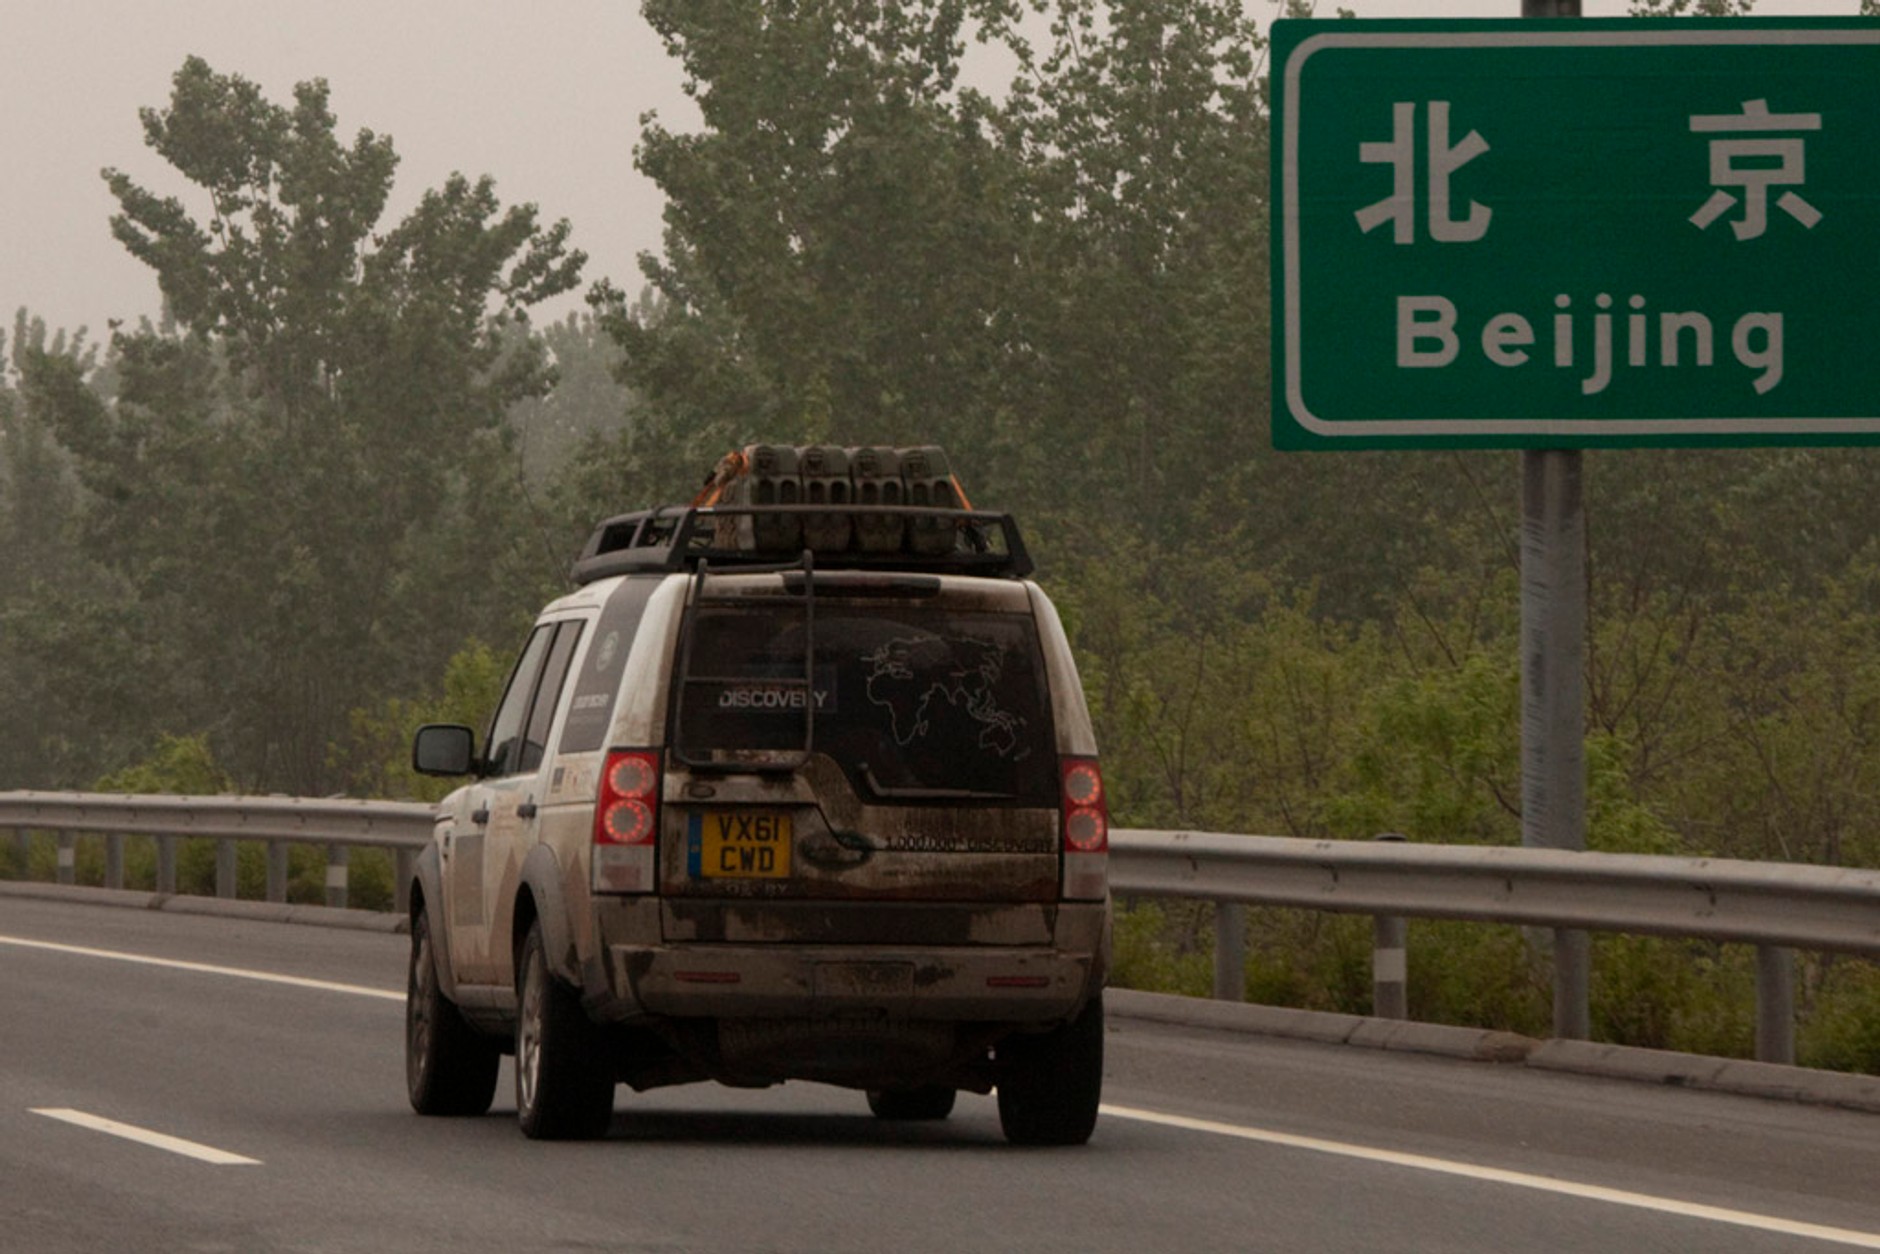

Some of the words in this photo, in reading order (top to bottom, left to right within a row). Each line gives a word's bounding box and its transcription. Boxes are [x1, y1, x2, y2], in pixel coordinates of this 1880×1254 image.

[1353, 98, 1824, 245] 北京
[1396, 293, 1785, 396] Beijing
[718, 815, 780, 841] VX61
[720, 846, 775, 872] CWD
